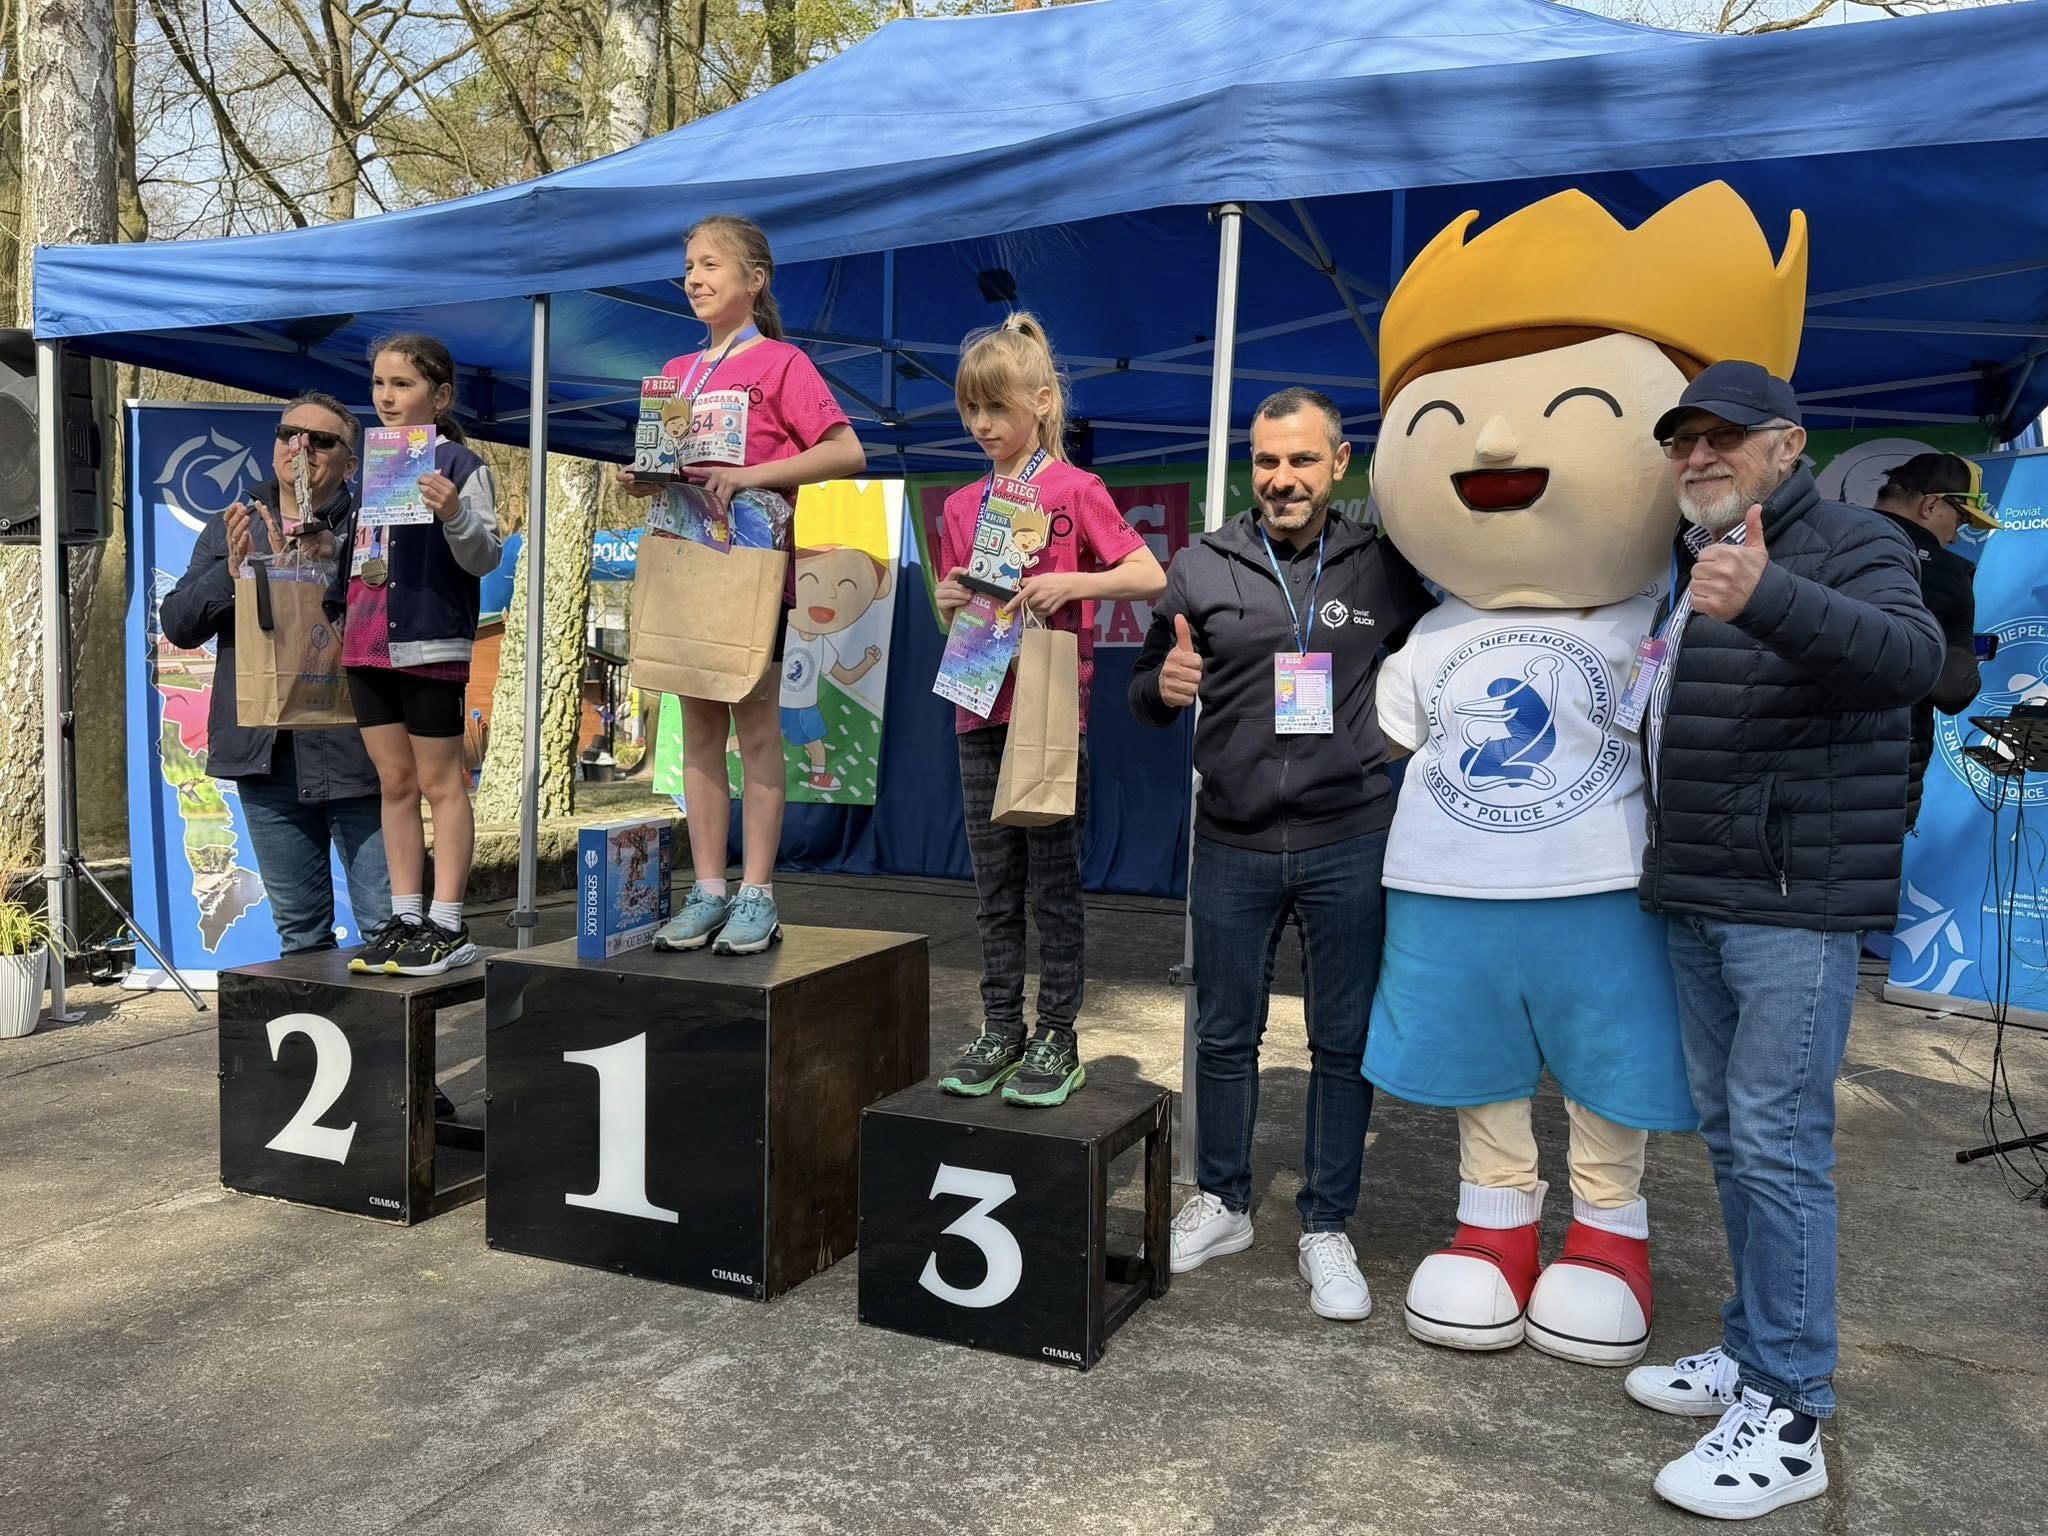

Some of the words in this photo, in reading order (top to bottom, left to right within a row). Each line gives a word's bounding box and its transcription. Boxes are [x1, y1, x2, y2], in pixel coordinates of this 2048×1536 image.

[644, 380, 650, 390] 7
[652, 380, 675, 390] BIEG
[695, 395, 740, 406] ORCZAKA
[692, 412, 714, 433] 54
[378, 432, 400, 440] BIEG
[996, 479, 1004, 489] 7
[1006, 482, 1035, 499] BIEG
[2005, 507, 2042, 518] Powiat
[991, 535, 1001, 549] 3
[592, 541, 638, 562] POLIC
[1353, 607, 1370, 618] owiat
[1353, 616, 1375, 626] OLICKI
[1430, 695, 1438, 727] DLA
[1437, 647, 1474, 689] DZIECI
[1480, 633, 1608, 725] NIEPEŁNOSPRAWNYC
[1569, 734, 1620, 802] UCHOWO
[1477, 806, 1545, 823] POLICE
[587, 874, 598, 905] SEMBO
[587, 907, 598, 936] BLOCK
[264, 1012, 357, 1165] 2
[563, 1031, 679, 1224] 1
[369, 1196, 401, 1209] CHABAS
[918, 1161, 1023, 1308] 3
[711, 1268, 753, 1285] CHABAS
[1042, 1346, 1082, 1362] CHABAS
